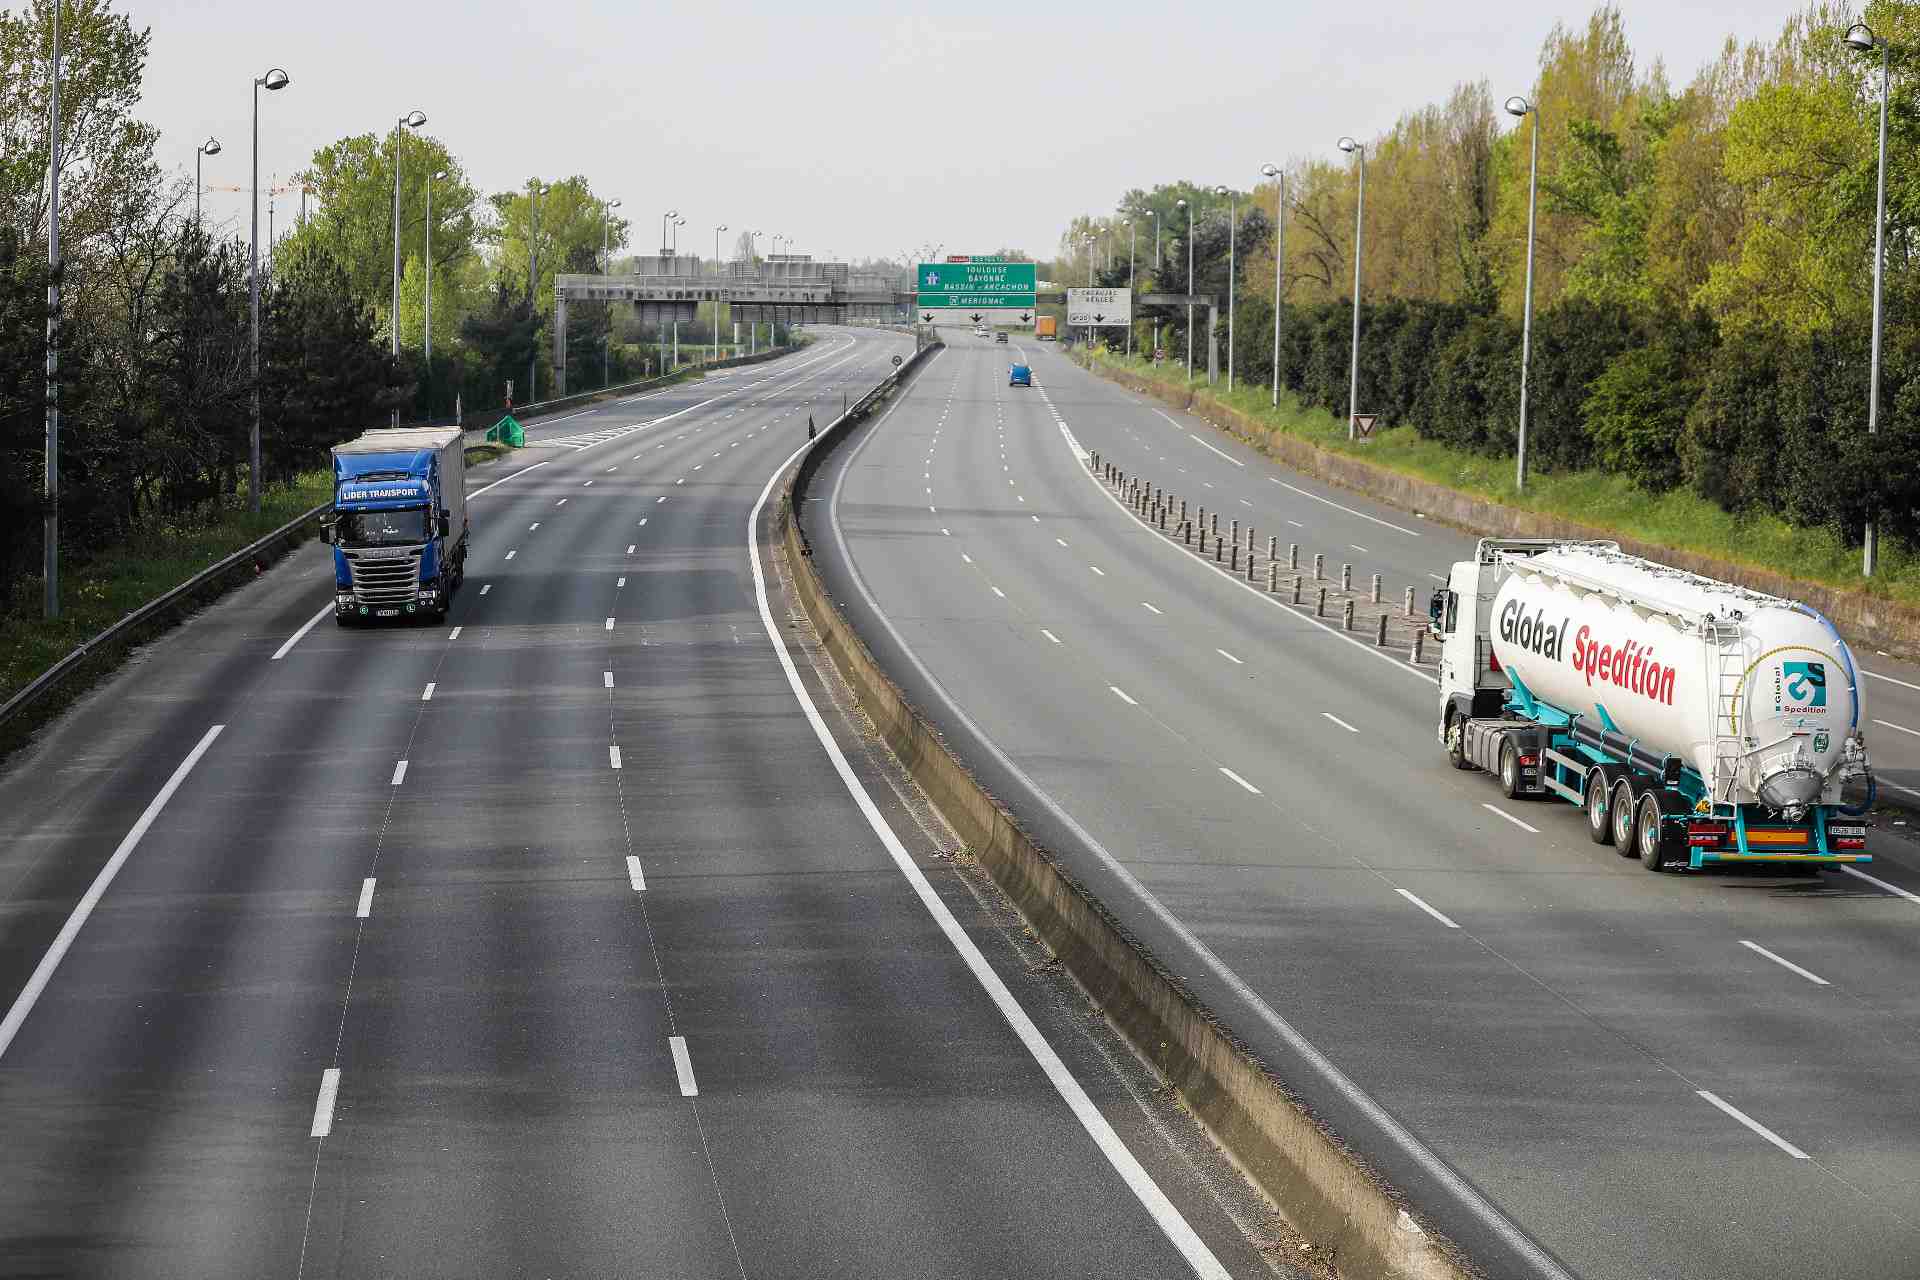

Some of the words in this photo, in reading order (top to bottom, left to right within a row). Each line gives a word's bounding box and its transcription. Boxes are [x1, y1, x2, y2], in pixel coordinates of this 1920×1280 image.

[966, 266, 1008, 274] TOULOUSE
[968, 274, 1005, 282] BAYONNE
[343, 490, 367, 500] LIDER
[369, 488, 418, 498] TRANSPORT
[1500, 599, 1570, 662] Global
[1572, 625, 1676, 706] Spedition
[1784, 705, 1826, 714] Spedition
